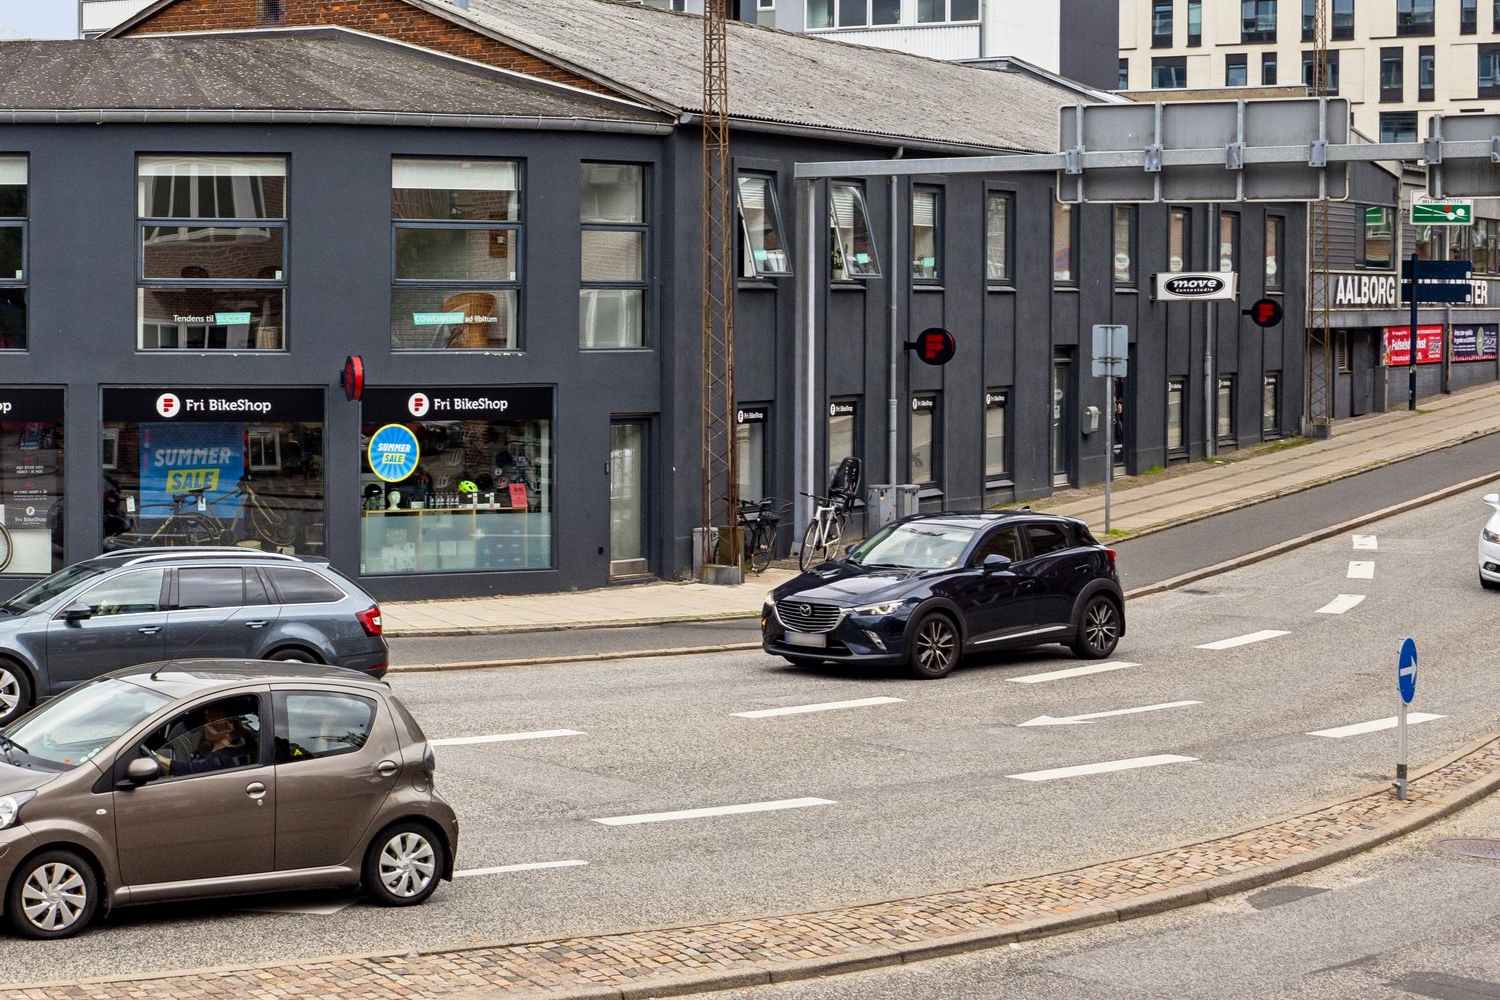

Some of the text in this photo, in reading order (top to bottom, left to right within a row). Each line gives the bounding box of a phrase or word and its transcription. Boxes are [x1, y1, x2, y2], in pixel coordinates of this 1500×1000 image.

[1172, 279, 1218, 288] move
[1336, 275, 1396, 305] AALBORG
[173, 313, 249, 324] Tendens til SUCCES
[414, 314, 498, 324] COWORKING ad libitum
[185, 399, 205, 411] Fri
[209, 399, 272, 414] BikeShop
[434, 398, 451, 410] Fri
[454, 398, 508, 412] BikeShop
[377, 443, 411, 453] SUMMER
[153, 447, 232, 467] SUMMER
[384, 454, 403, 463] SALE
[170, 471, 215, 490] SALE
